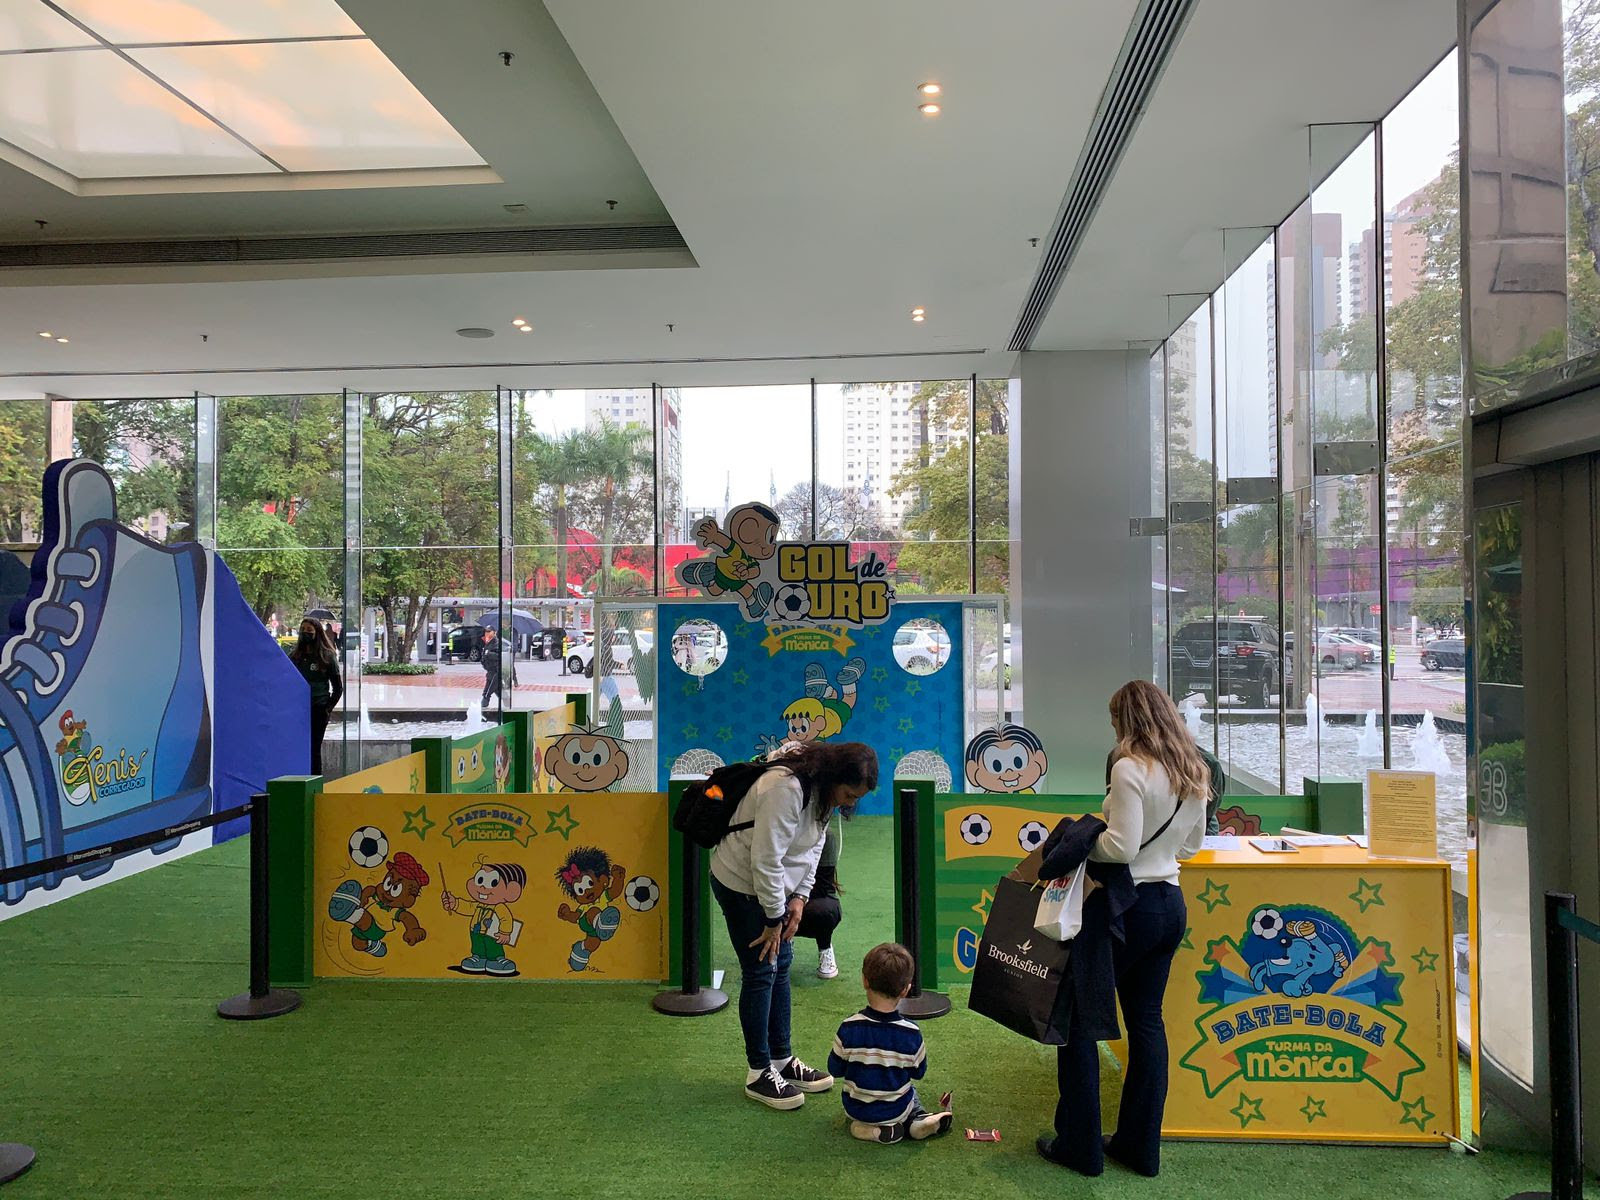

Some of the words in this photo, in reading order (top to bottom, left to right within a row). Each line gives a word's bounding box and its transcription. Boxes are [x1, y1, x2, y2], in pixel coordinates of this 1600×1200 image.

[778, 544, 857, 582] GOL
[860, 552, 886, 578] de
[455, 809, 524, 826] BATE-BOLA
[953, 926, 982, 974] G
[988, 944, 1049, 980] Brooksfield
[1211, 1004, 1386, 1047] BATE-BOLA
[1265, 1041, 1313, 1053] TURMA
[1314, 1041, 1333, 1053] DA
